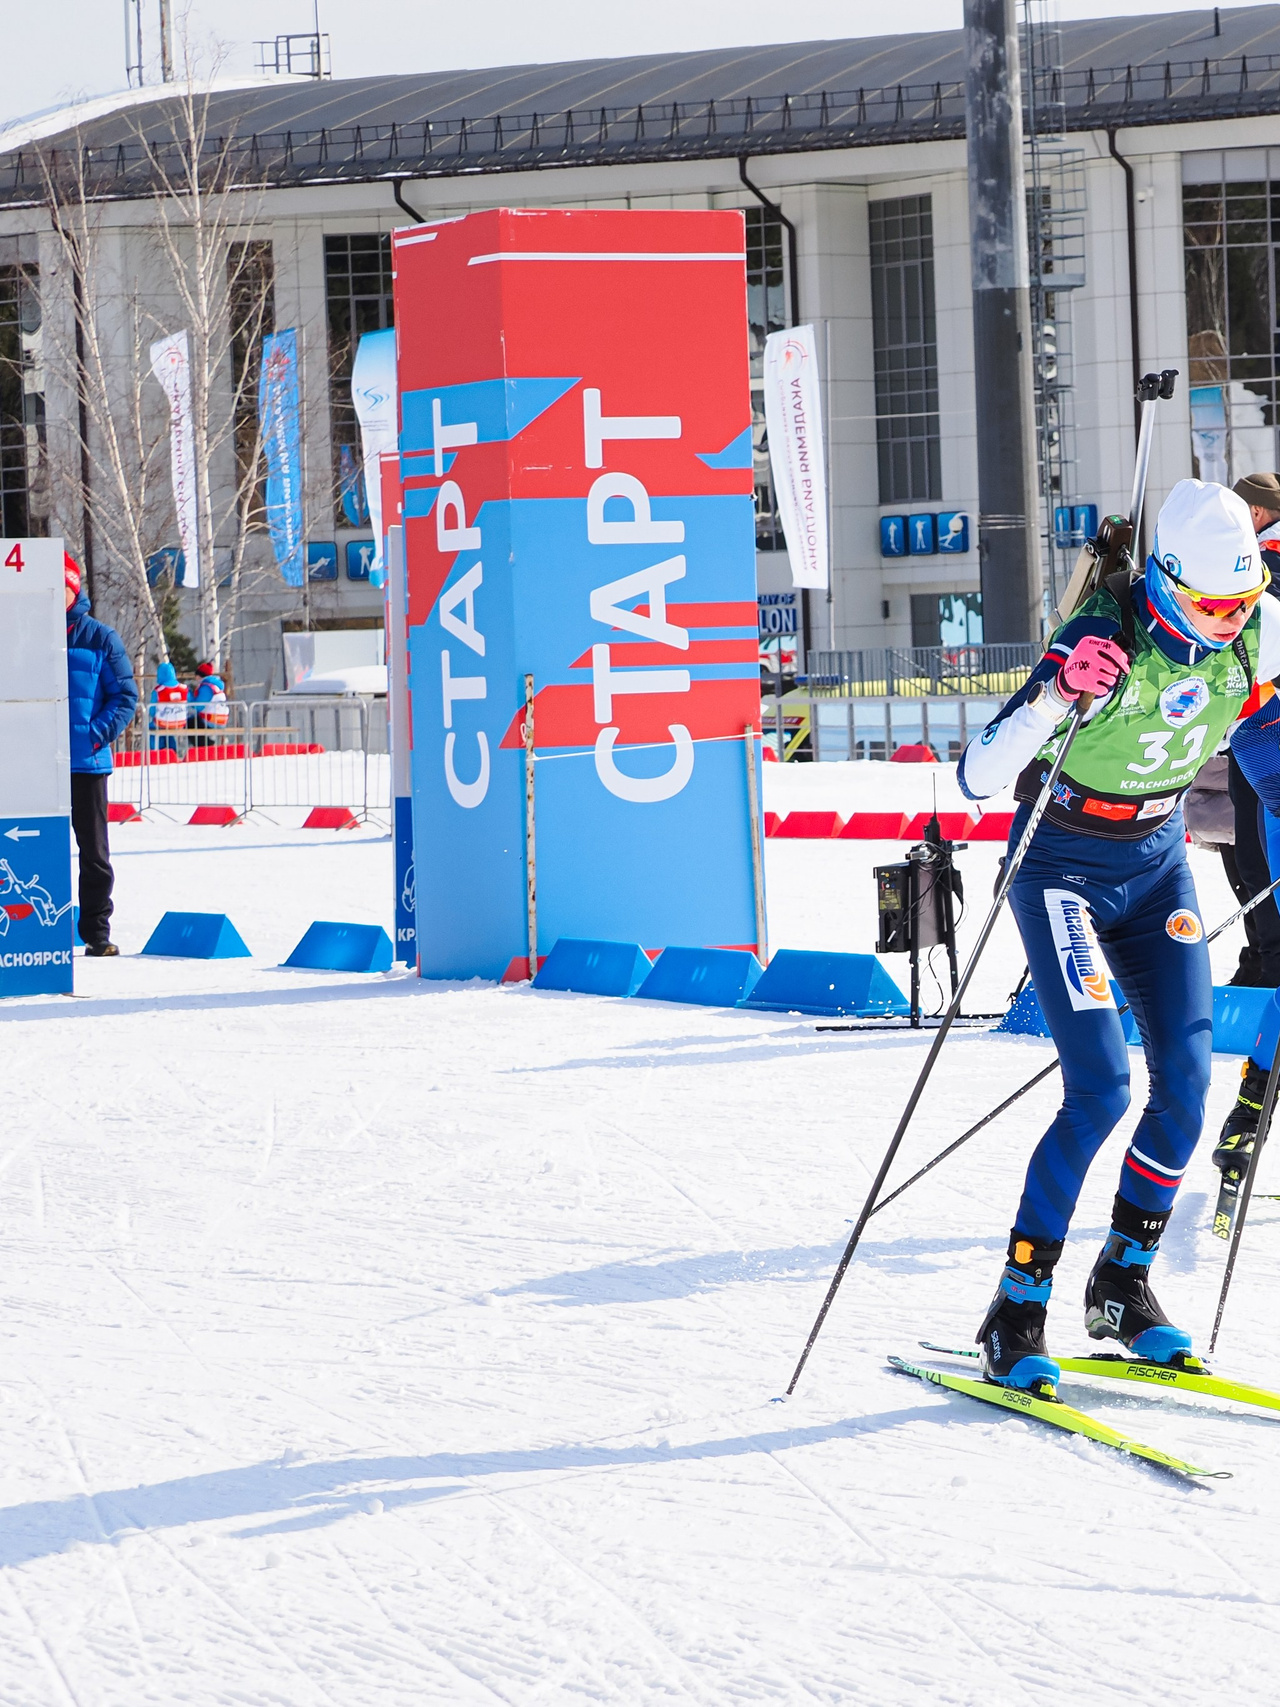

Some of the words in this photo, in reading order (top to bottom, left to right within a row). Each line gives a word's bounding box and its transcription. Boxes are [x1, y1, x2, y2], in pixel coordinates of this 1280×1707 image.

[4, 543, 25, 573] 4
[432, 398, 491, 808] СТАРТ
[583, 388, 695, 803] СТАРТ
[1126, 724, 1209, 775] 31
[1119, 769, 1196, 790] КРАСНОЯРСК
[1142, 1219, 1163, 1230] 181
[1126, 1365, 1178, 1382] FISCHER
[1001, 1390, 1033, 1409] FISCHER
